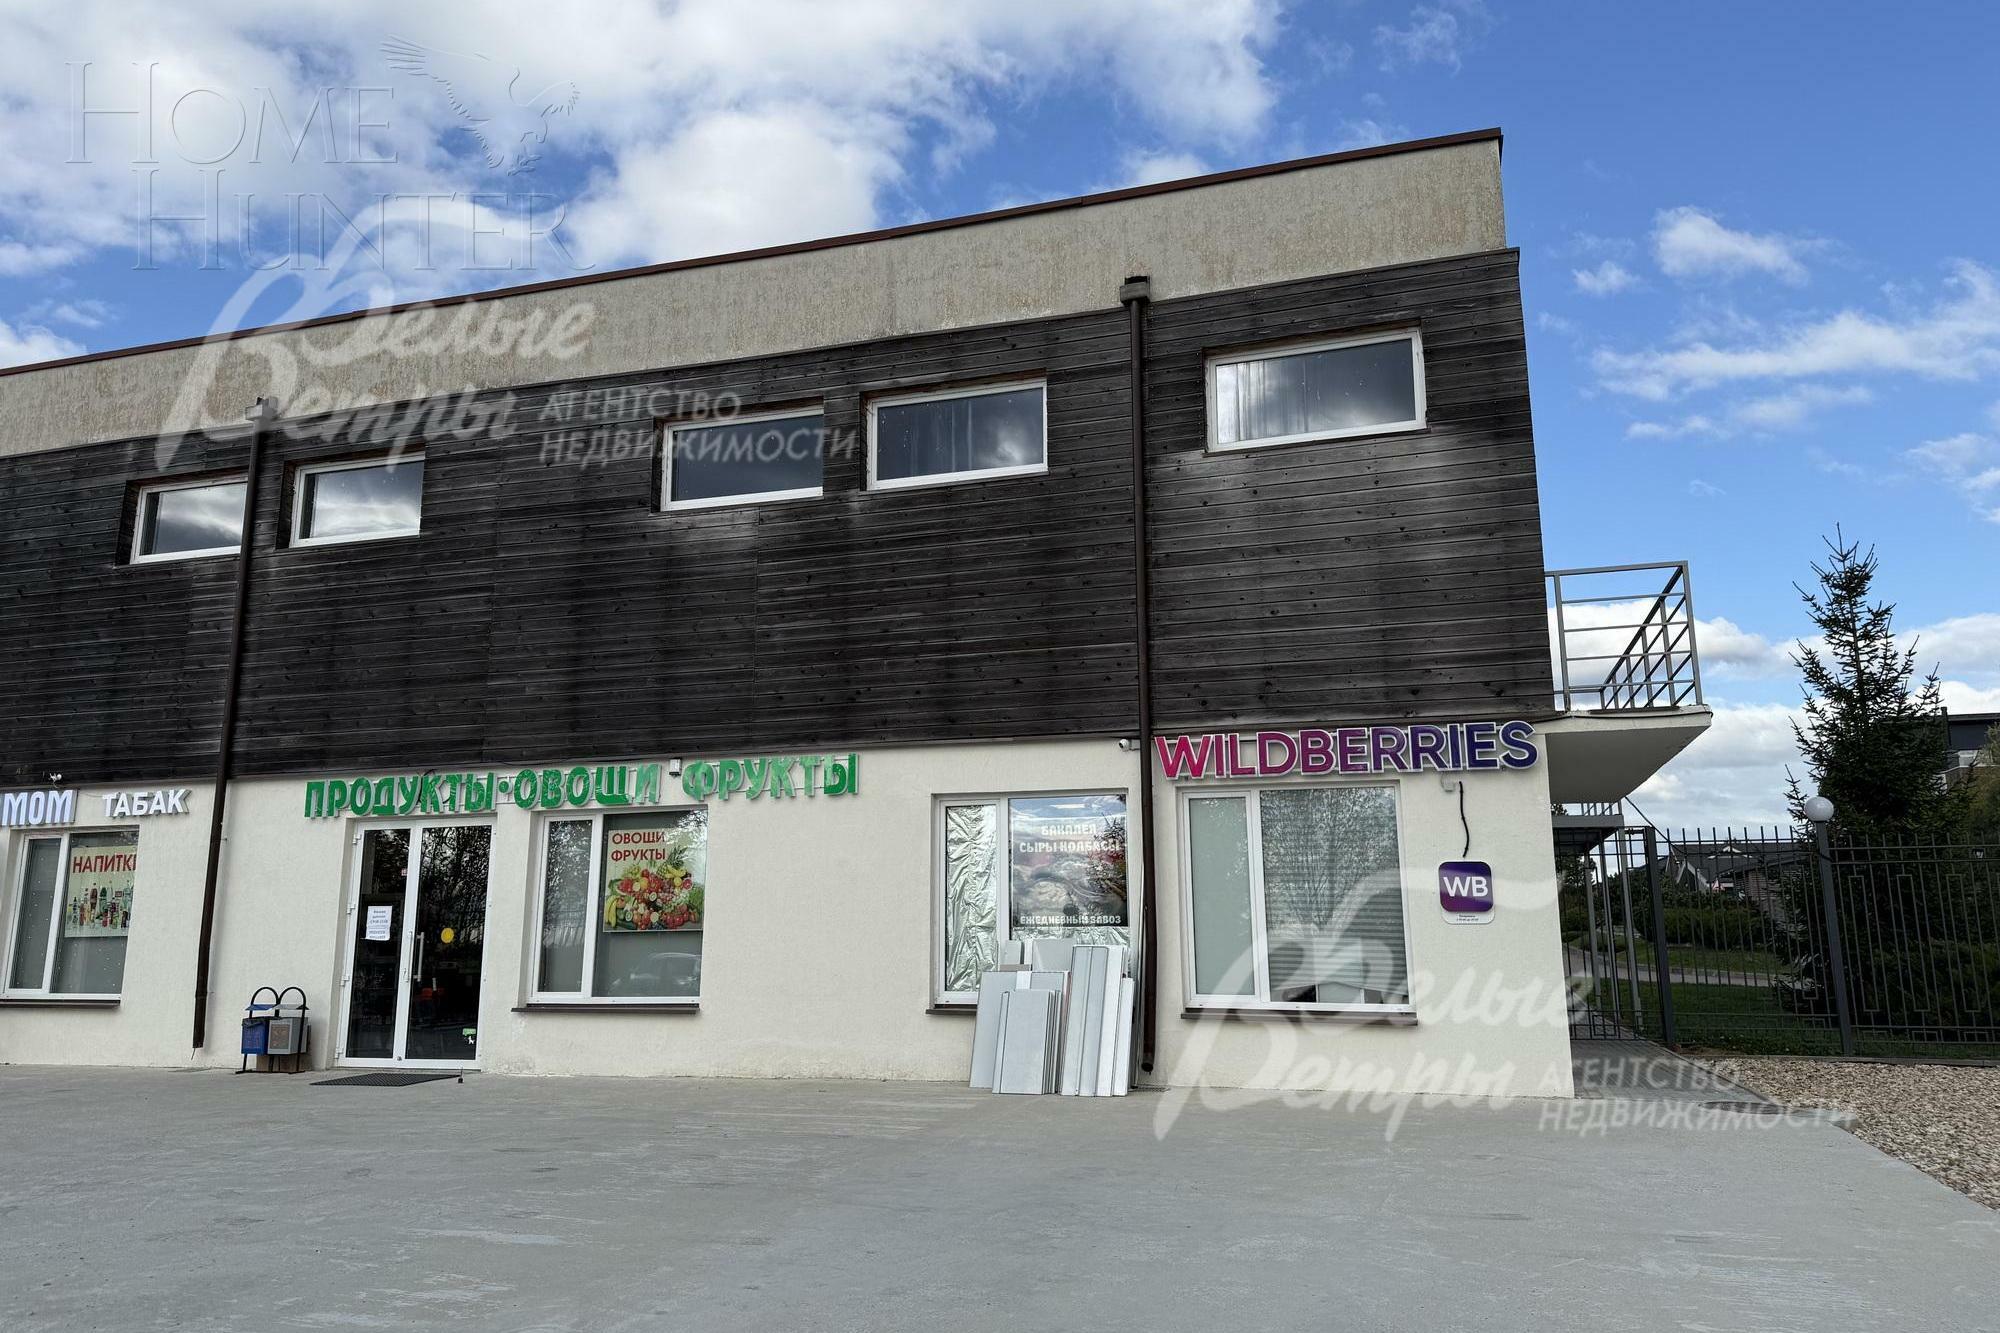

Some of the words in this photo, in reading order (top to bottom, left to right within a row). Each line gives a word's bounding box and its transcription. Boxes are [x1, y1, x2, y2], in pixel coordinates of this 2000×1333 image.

[1154, 720, 1539, 780] WILDBERRIES
[304, 772, 496, 819] ПРОДУКТЫ
[513, 763, 662, 810] ОВОЩИ
[682, 752, 860, 802] ФРУКТЫ
[103, 788, 191, 818] ТАБАК
[612, 831, 665, 845] ОВОЩИ
[1019, 841, 1057, 854] СЫРЫ
[611, 848, 666, 862] ФРУКТЫ
[1443, 876, 1488, 897] WB
